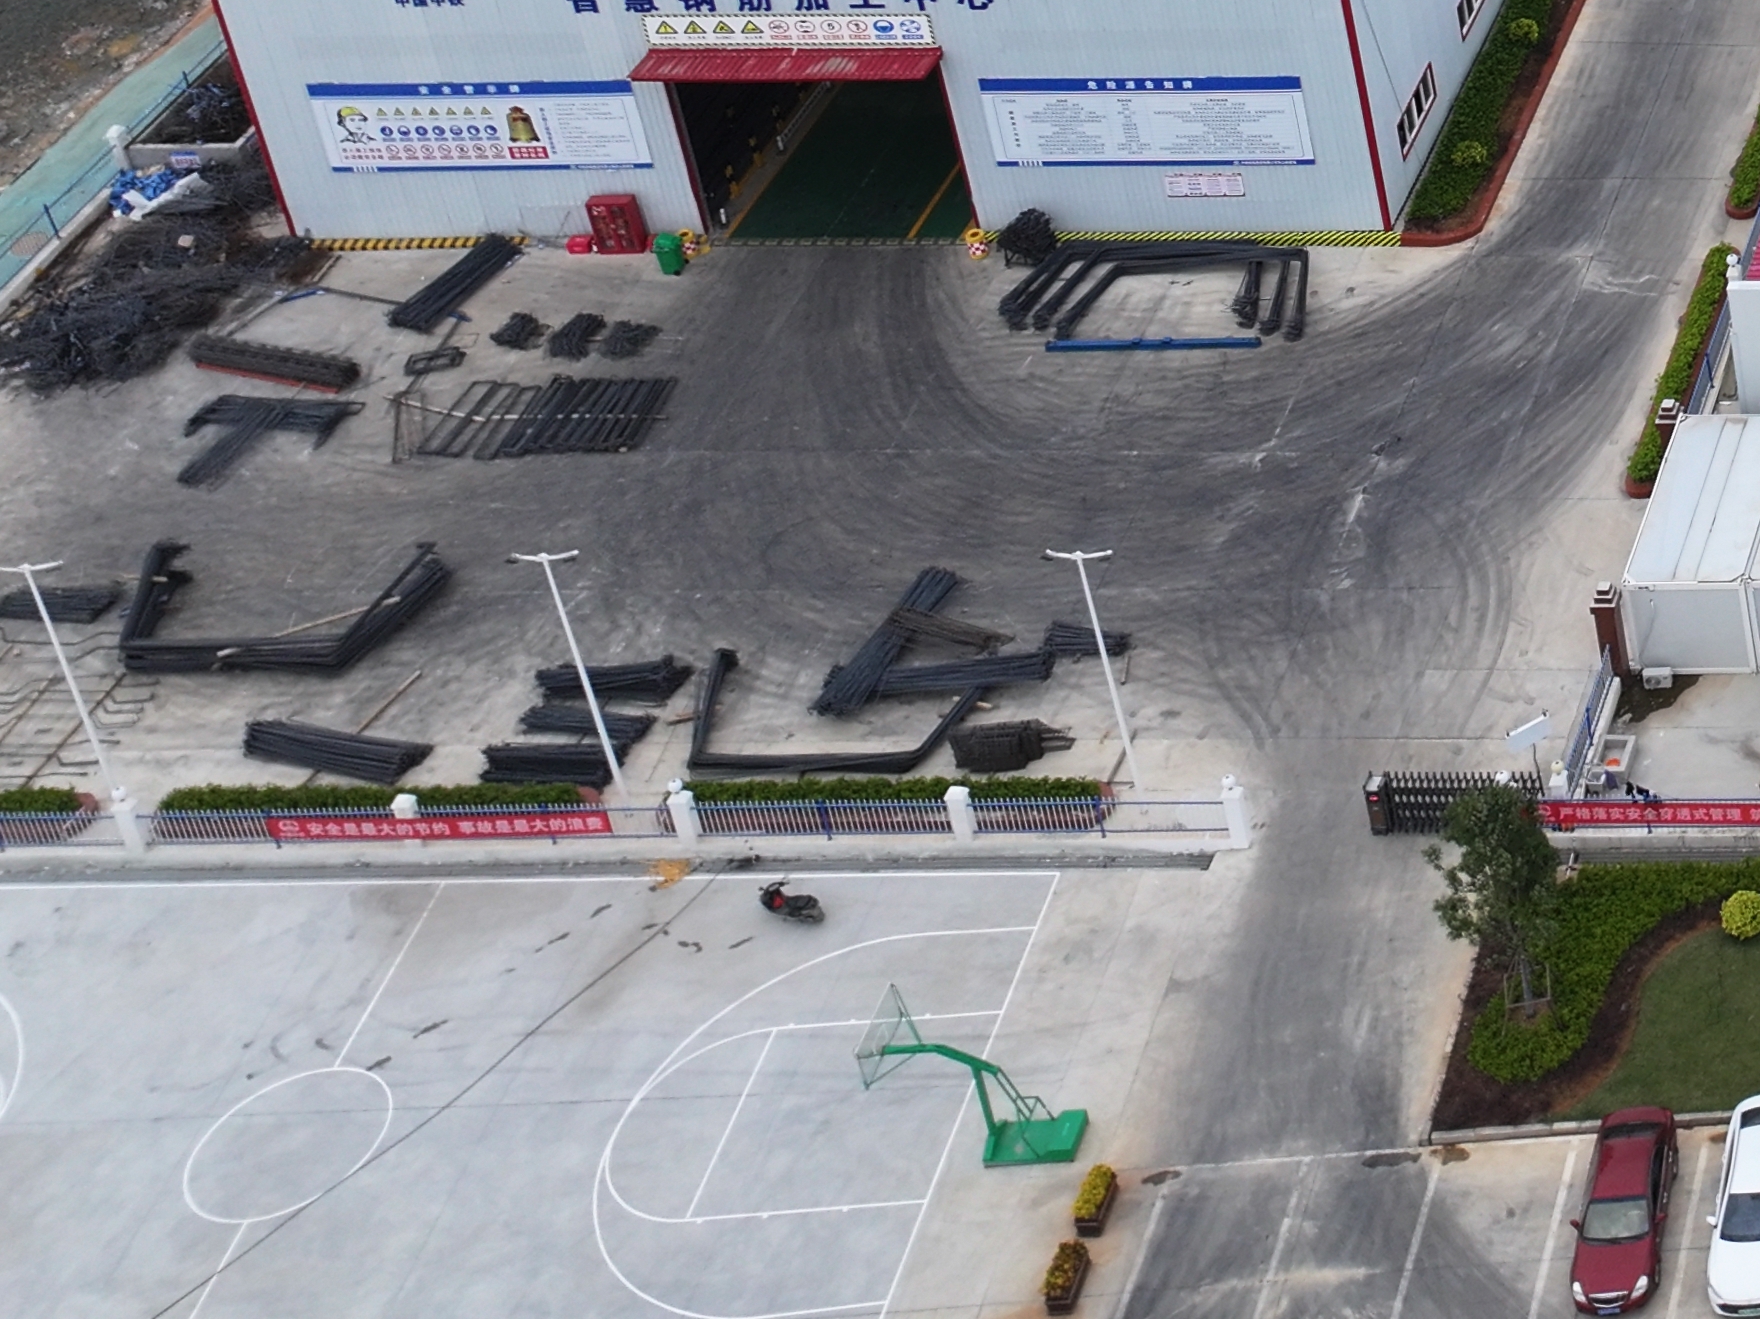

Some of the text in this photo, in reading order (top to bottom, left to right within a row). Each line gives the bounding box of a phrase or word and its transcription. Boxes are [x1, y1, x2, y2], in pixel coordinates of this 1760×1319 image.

[1558, 806, 1742, 821] 严格落实安全穿透式管理
[306, 818, 603, 837] 安全是最大的节约 事故是最大的浪费
